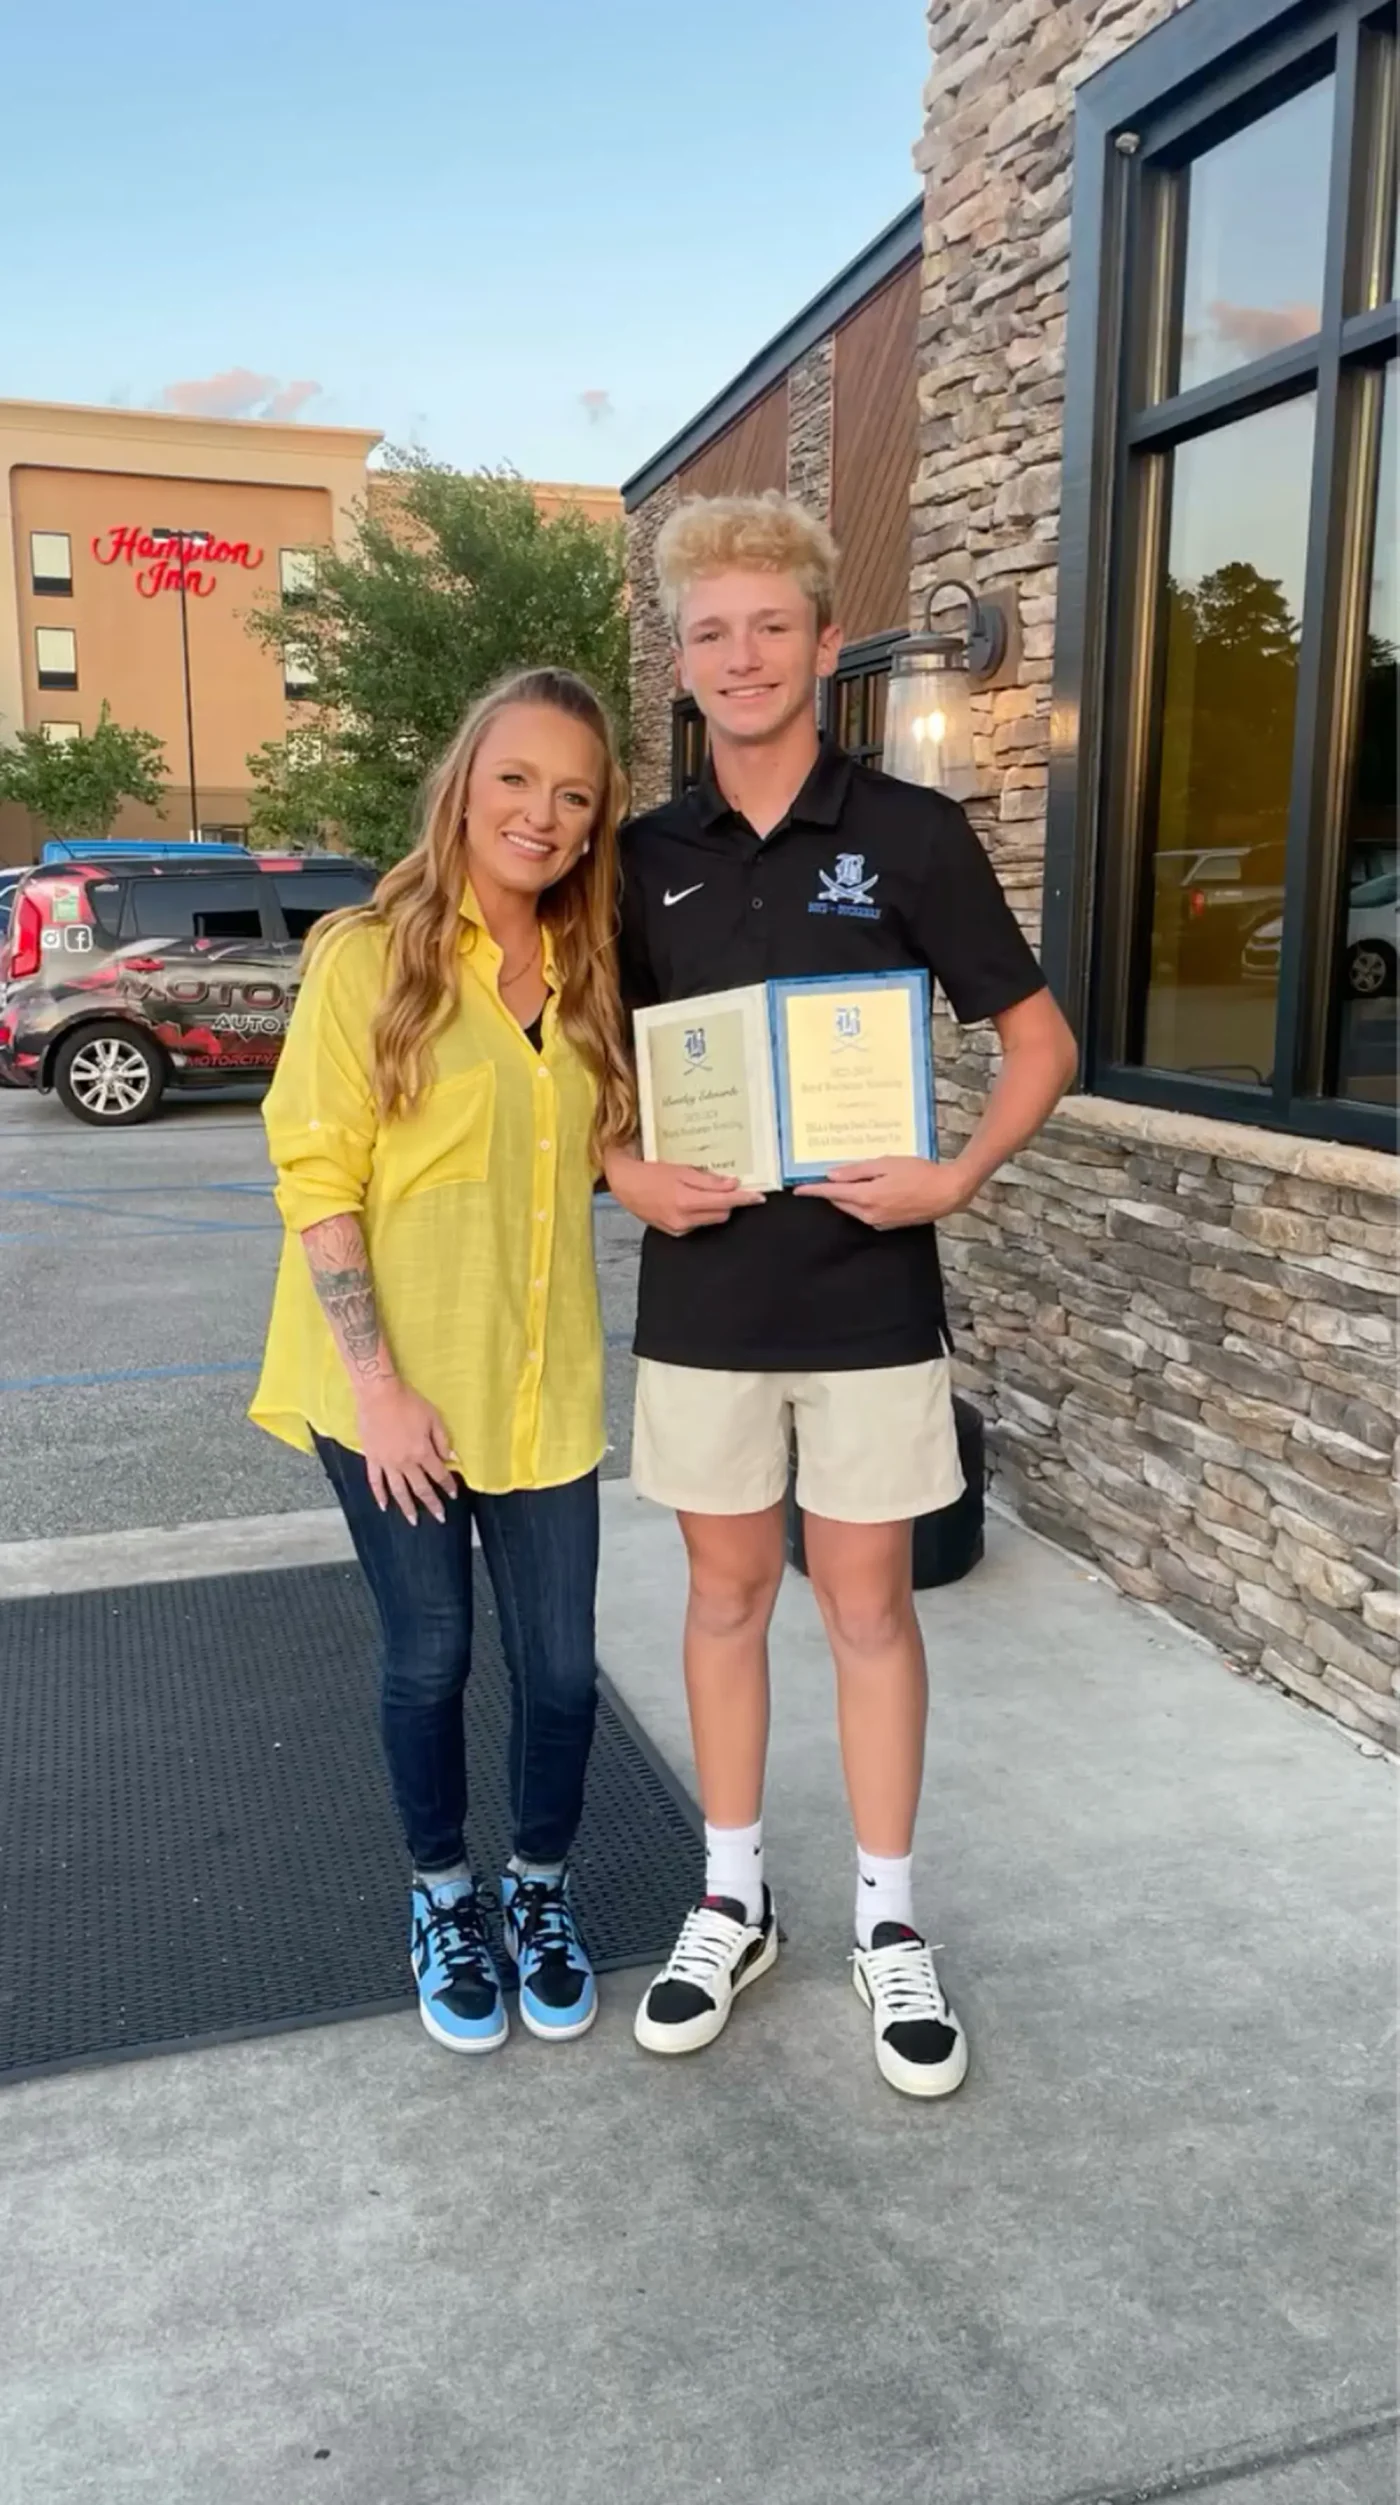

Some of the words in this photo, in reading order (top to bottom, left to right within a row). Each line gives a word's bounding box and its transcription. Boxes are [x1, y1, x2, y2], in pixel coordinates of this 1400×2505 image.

[91, 526, 264, 570] Hampton
[135, 560, 216, 599] Inn
[211, 1012, 280, 1034] AUTO
